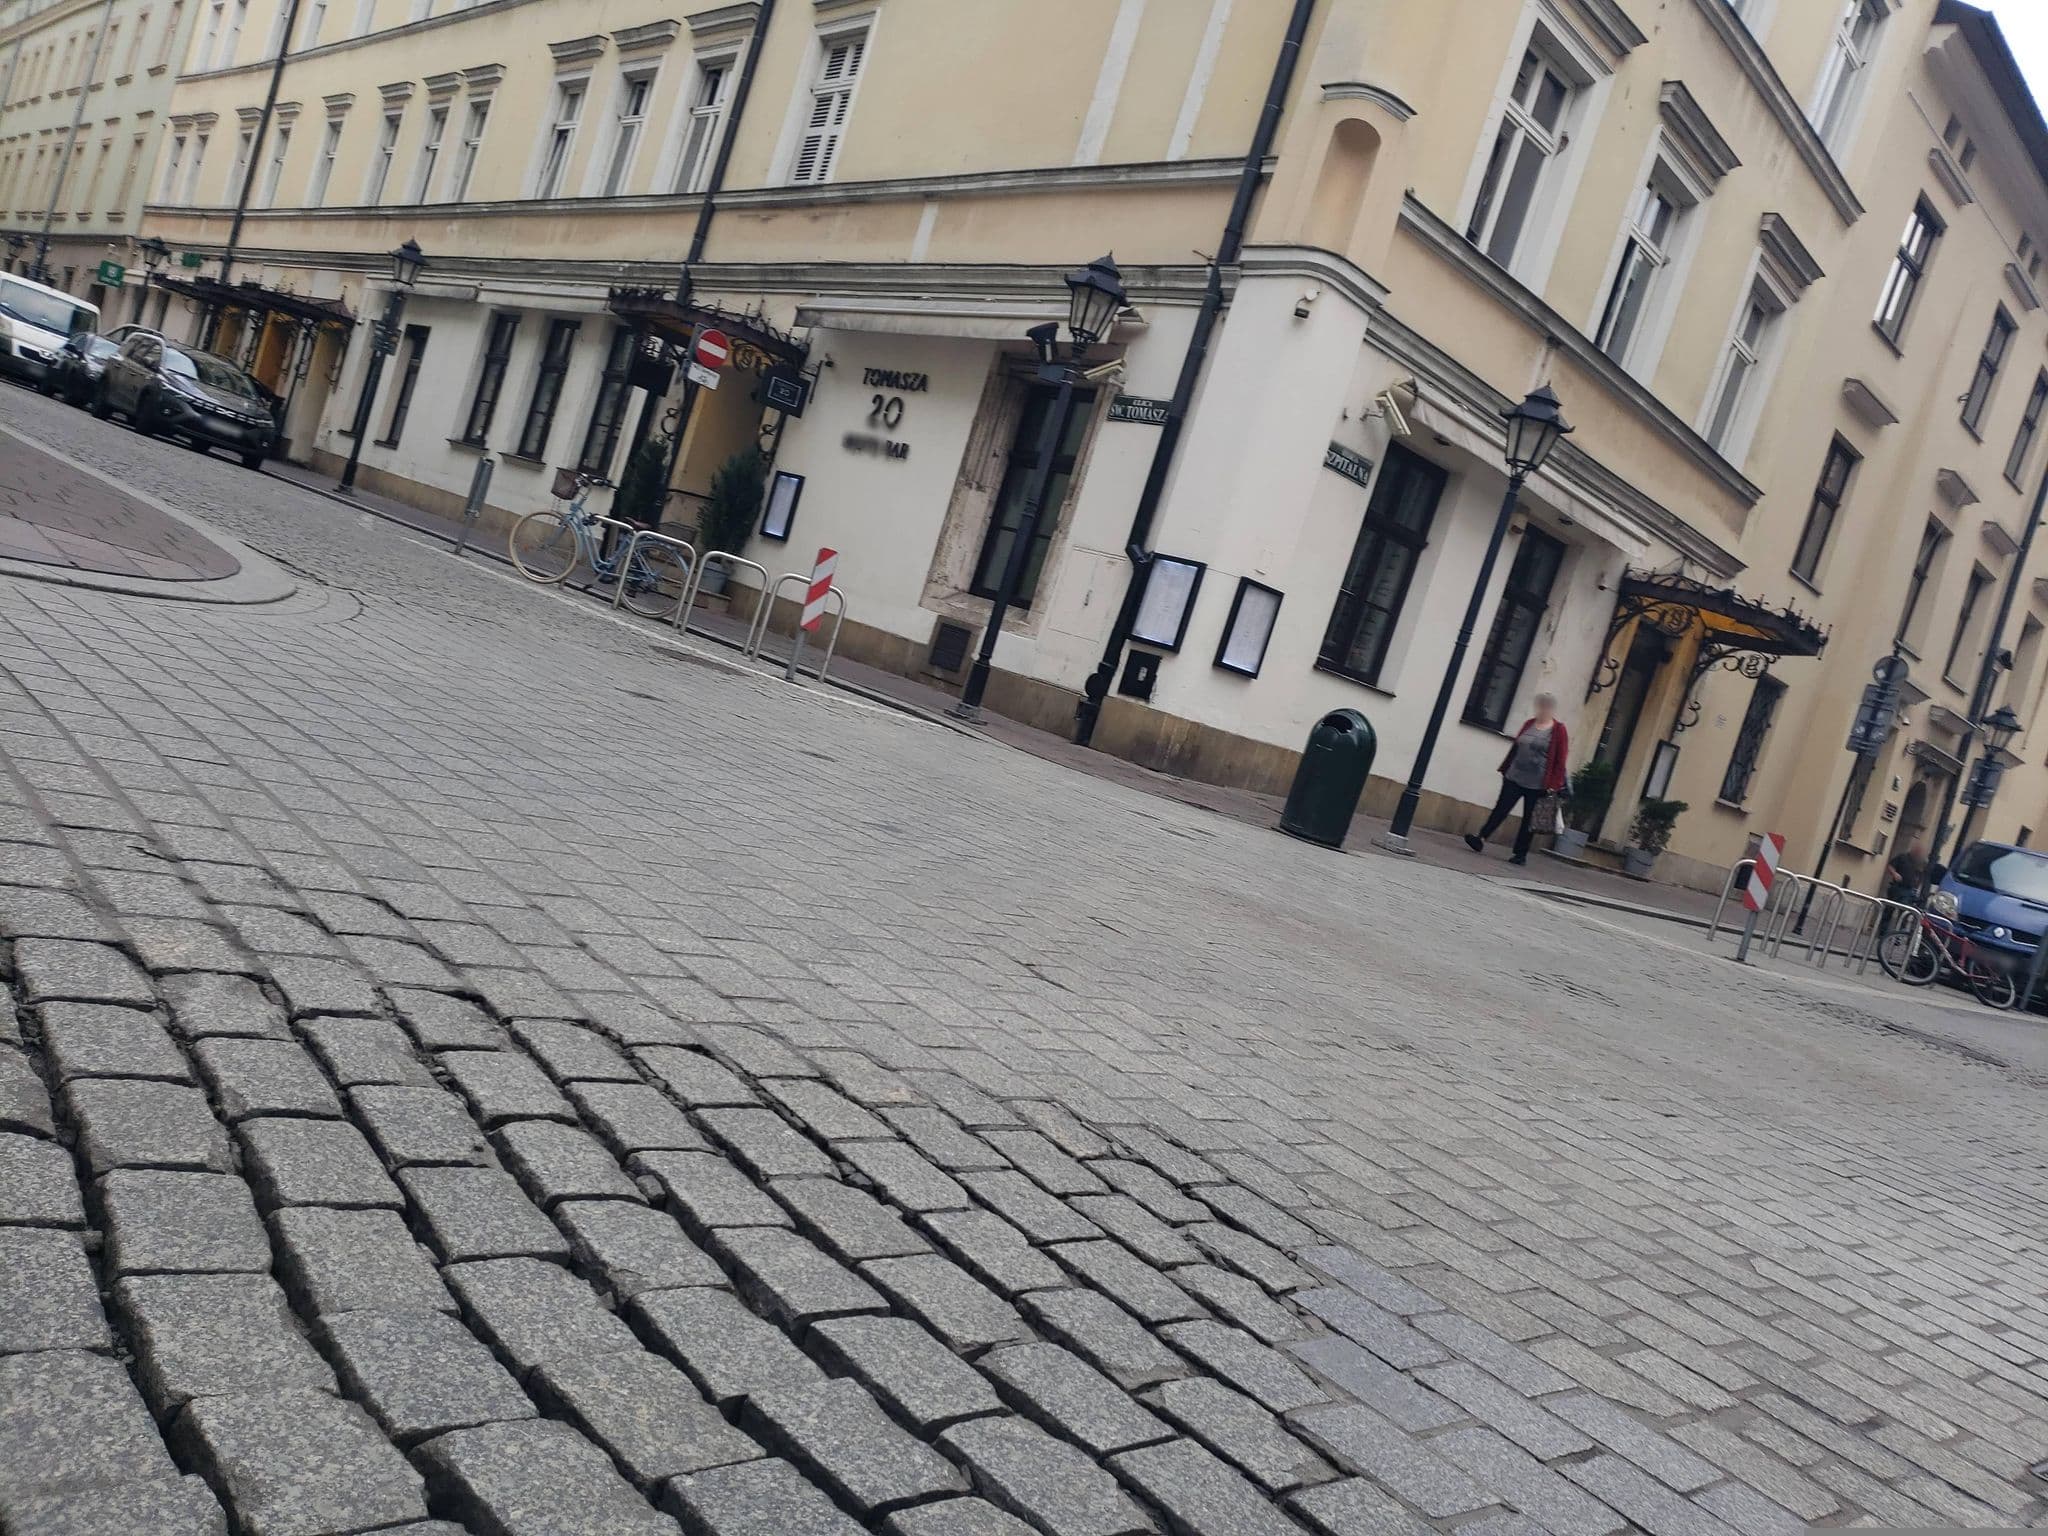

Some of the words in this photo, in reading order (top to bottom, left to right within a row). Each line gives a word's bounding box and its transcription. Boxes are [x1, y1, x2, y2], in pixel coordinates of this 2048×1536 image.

[862, 367, 929, 392] TOMASZA
[868, 393, 905, 430] 20
[1327, 451, 1368, 484] ZPITALNA
